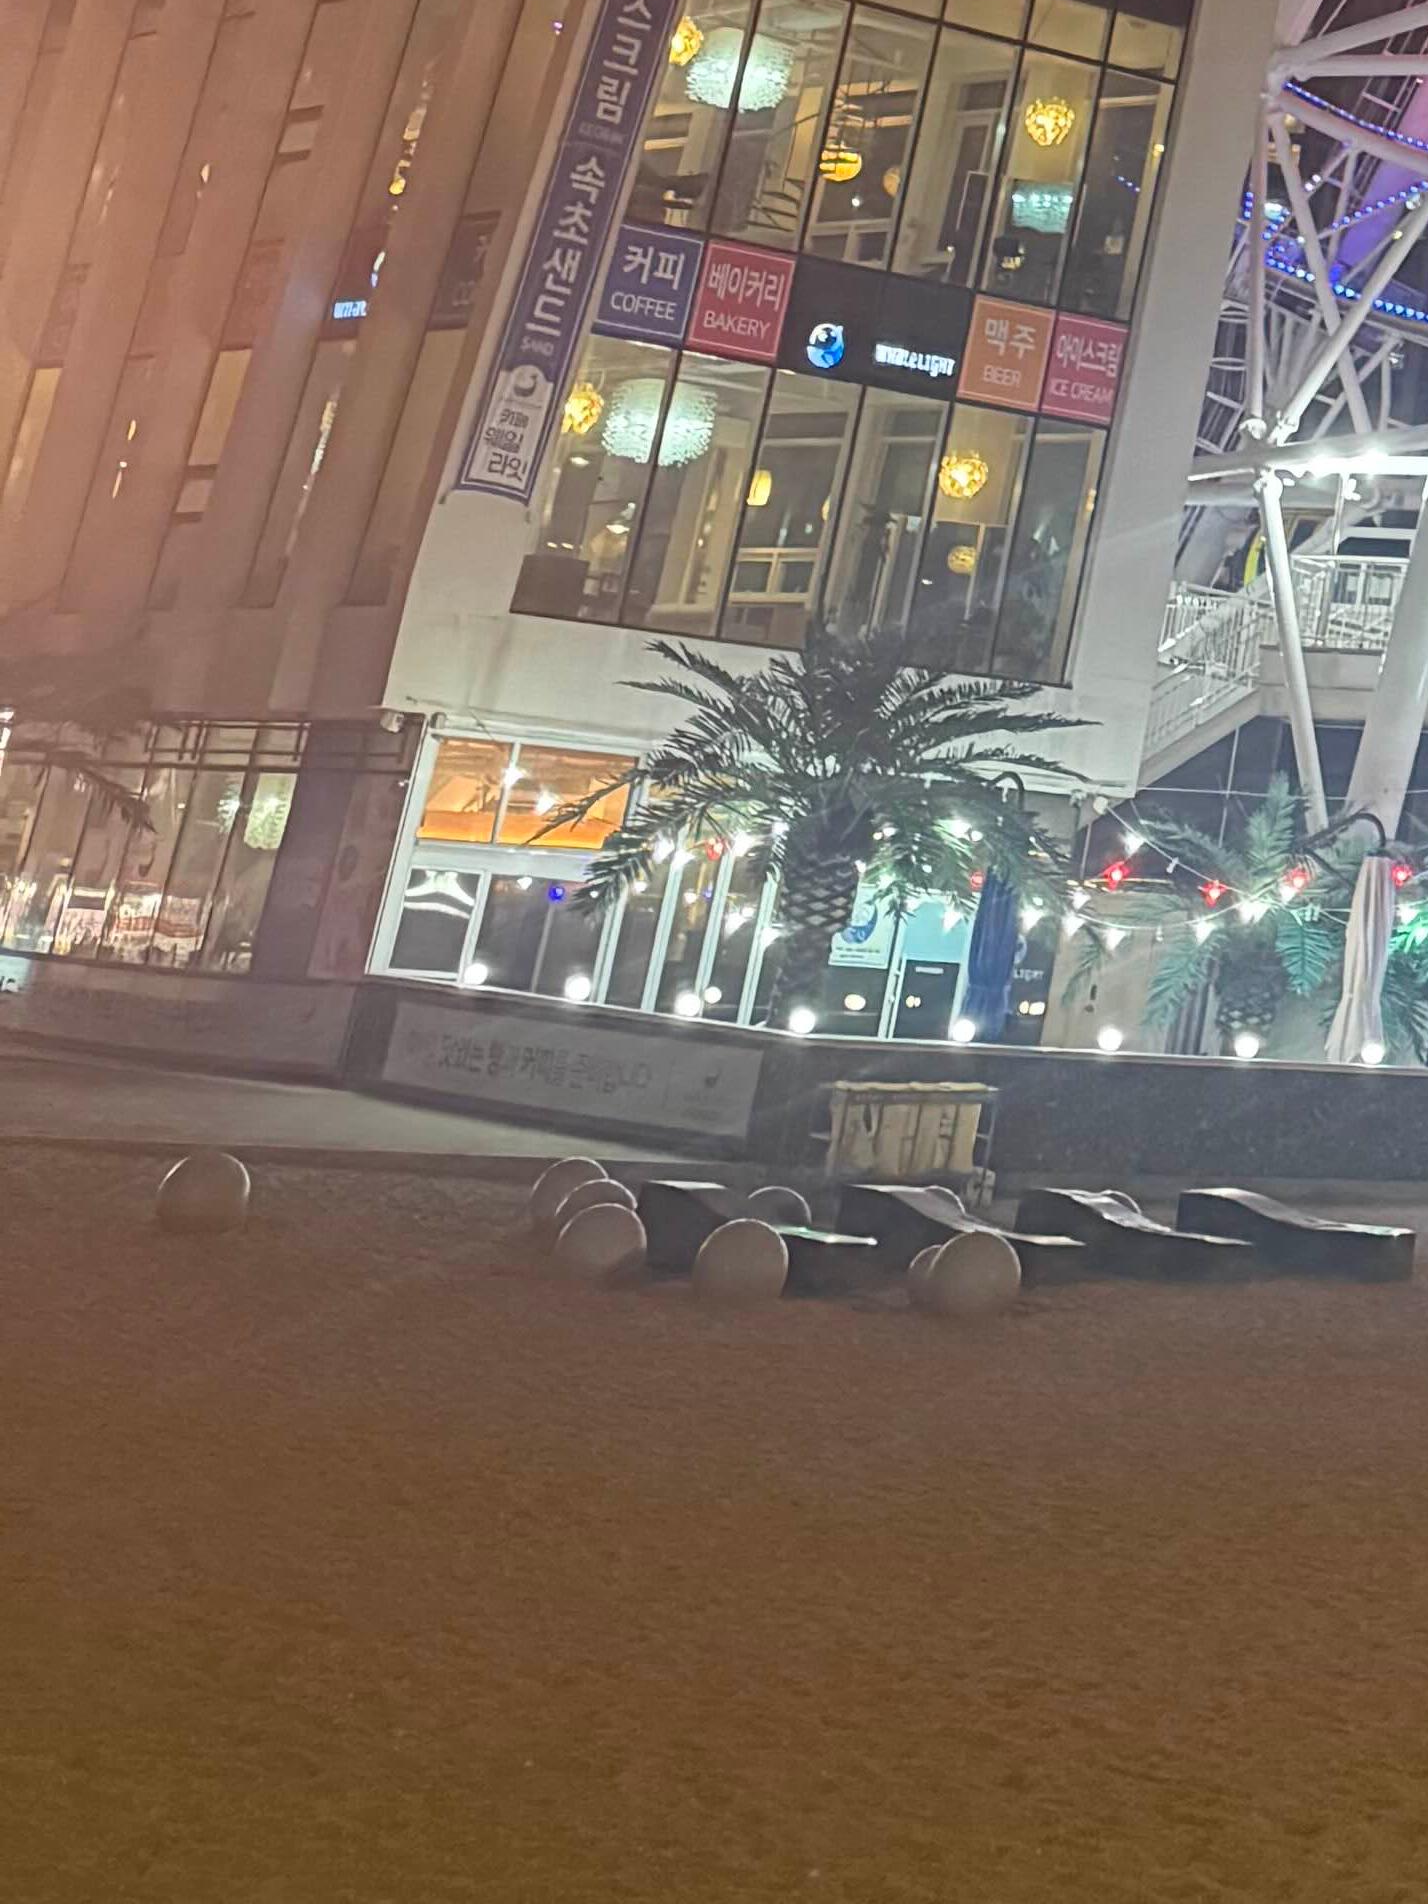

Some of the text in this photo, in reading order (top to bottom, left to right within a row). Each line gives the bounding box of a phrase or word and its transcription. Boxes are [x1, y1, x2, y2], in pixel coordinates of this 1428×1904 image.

[622, 245, 685, 291] 커피
[708, 263, 785, 312] 베이커리
[610, 292, 678, 320] COFFEE
[703, 310, 771, 339] BAKERY
[984, 318, 1037, 361] 맥주
[1056, 334, 1122, 379] 아이스크림
[983, 364, 1023, 389] BEER
[1051, 376, 1114, 404] ICE CREAM
[487, 452, 528, 482] 라잇
